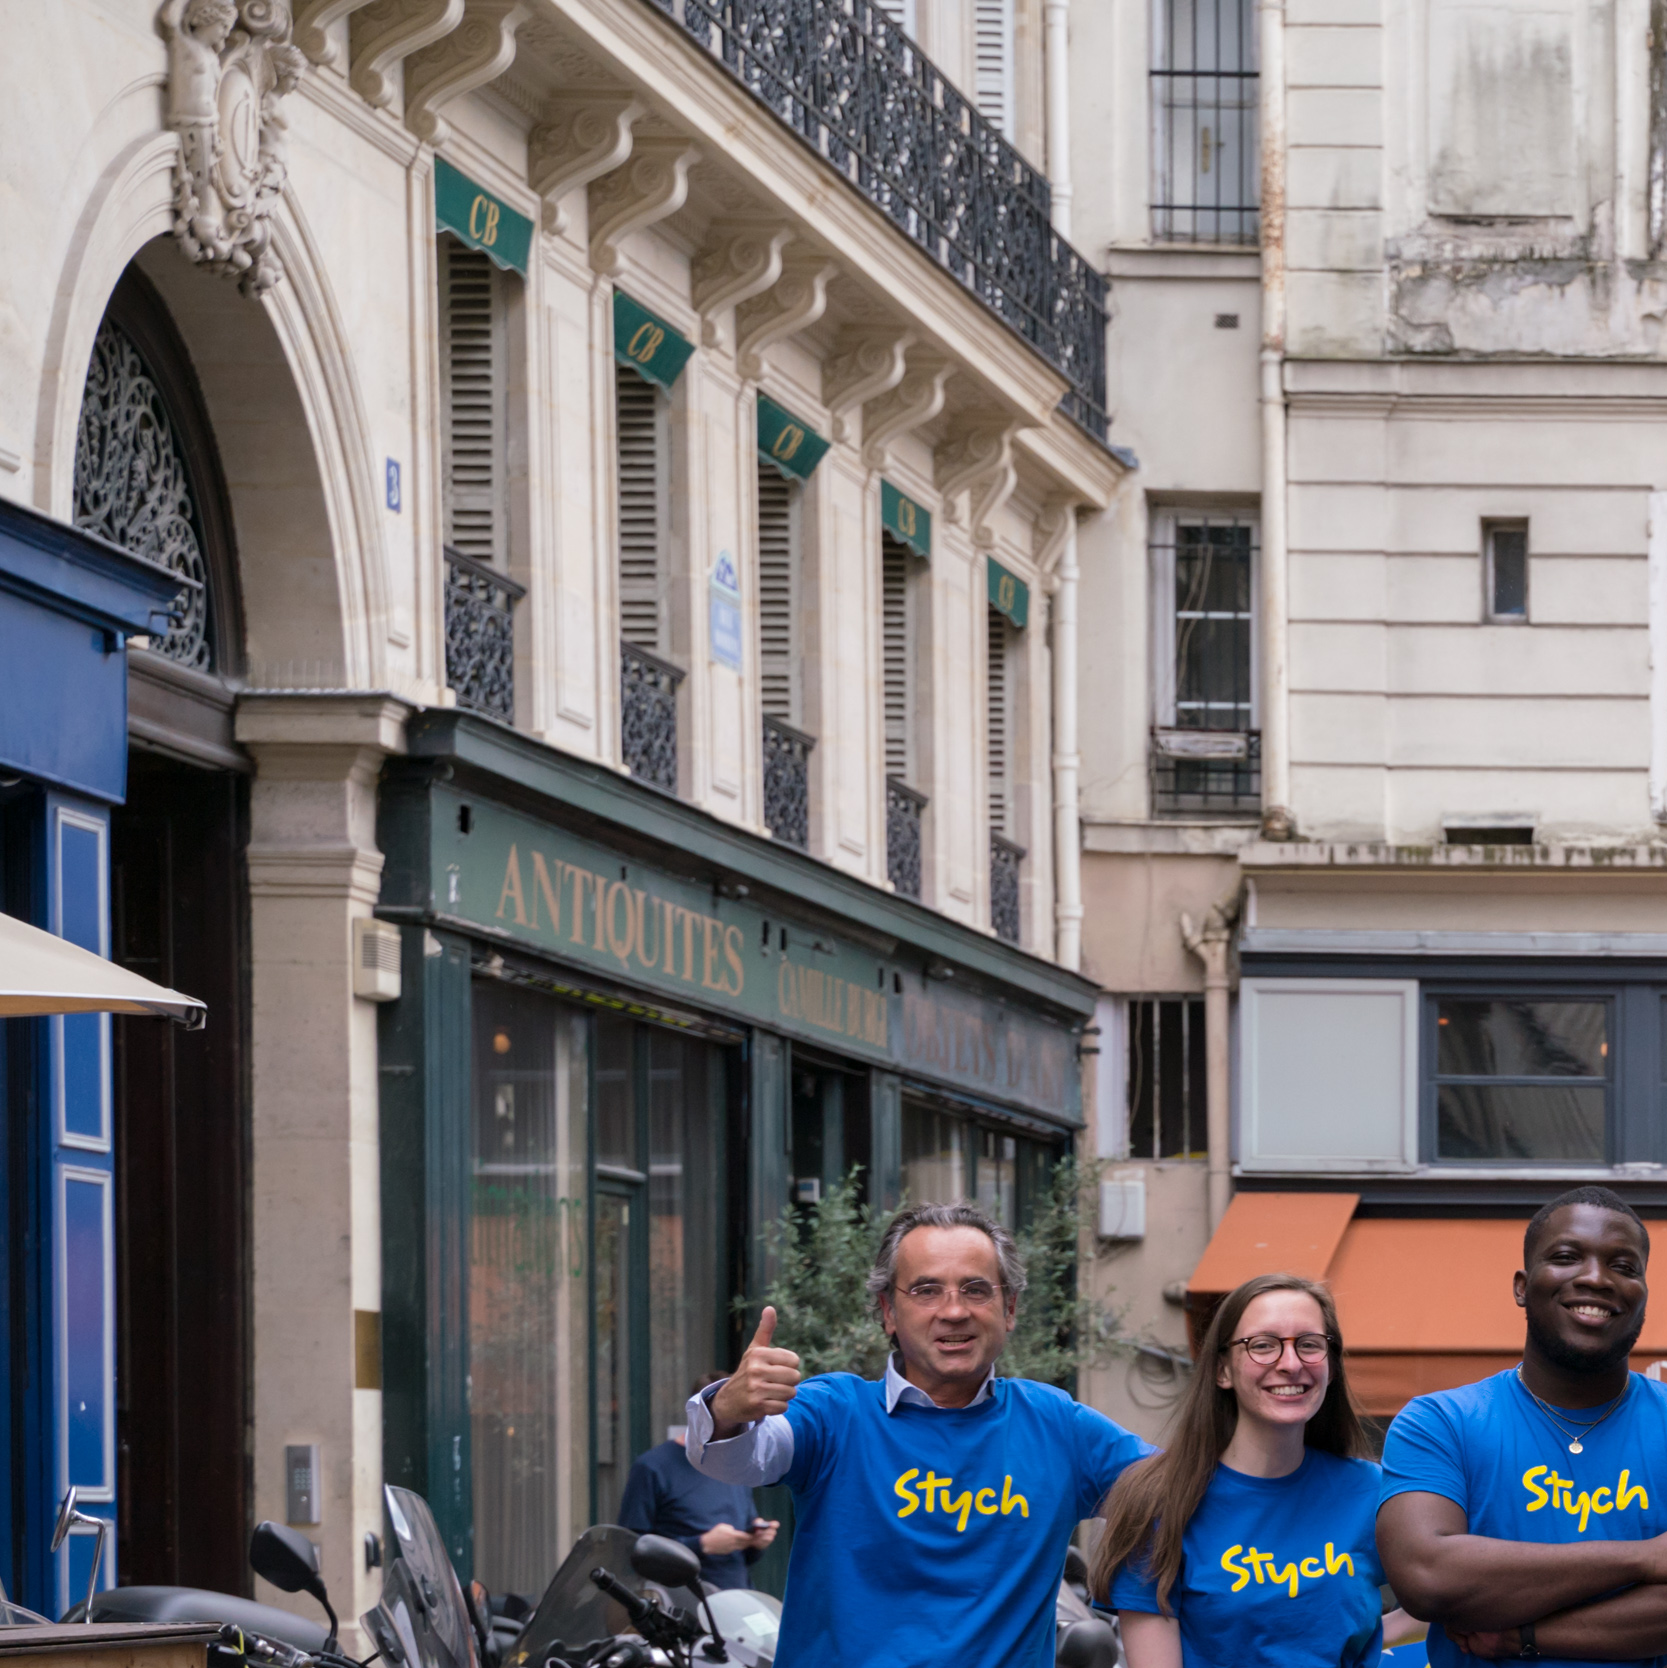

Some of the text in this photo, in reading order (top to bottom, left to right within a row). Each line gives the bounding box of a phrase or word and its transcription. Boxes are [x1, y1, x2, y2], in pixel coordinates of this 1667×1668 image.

[469, 195, 500, 246] CB
[627, 322, 664, 363] CB
[389, 465, 399, 506] 3
[495, 843, 745, 997] ANTIQUITES
[894, 1468, 1029, 1532] Stych
[1522, 1466, 1649, 1532] Stych
[1221, 1542, 1354, 1598] Stych
